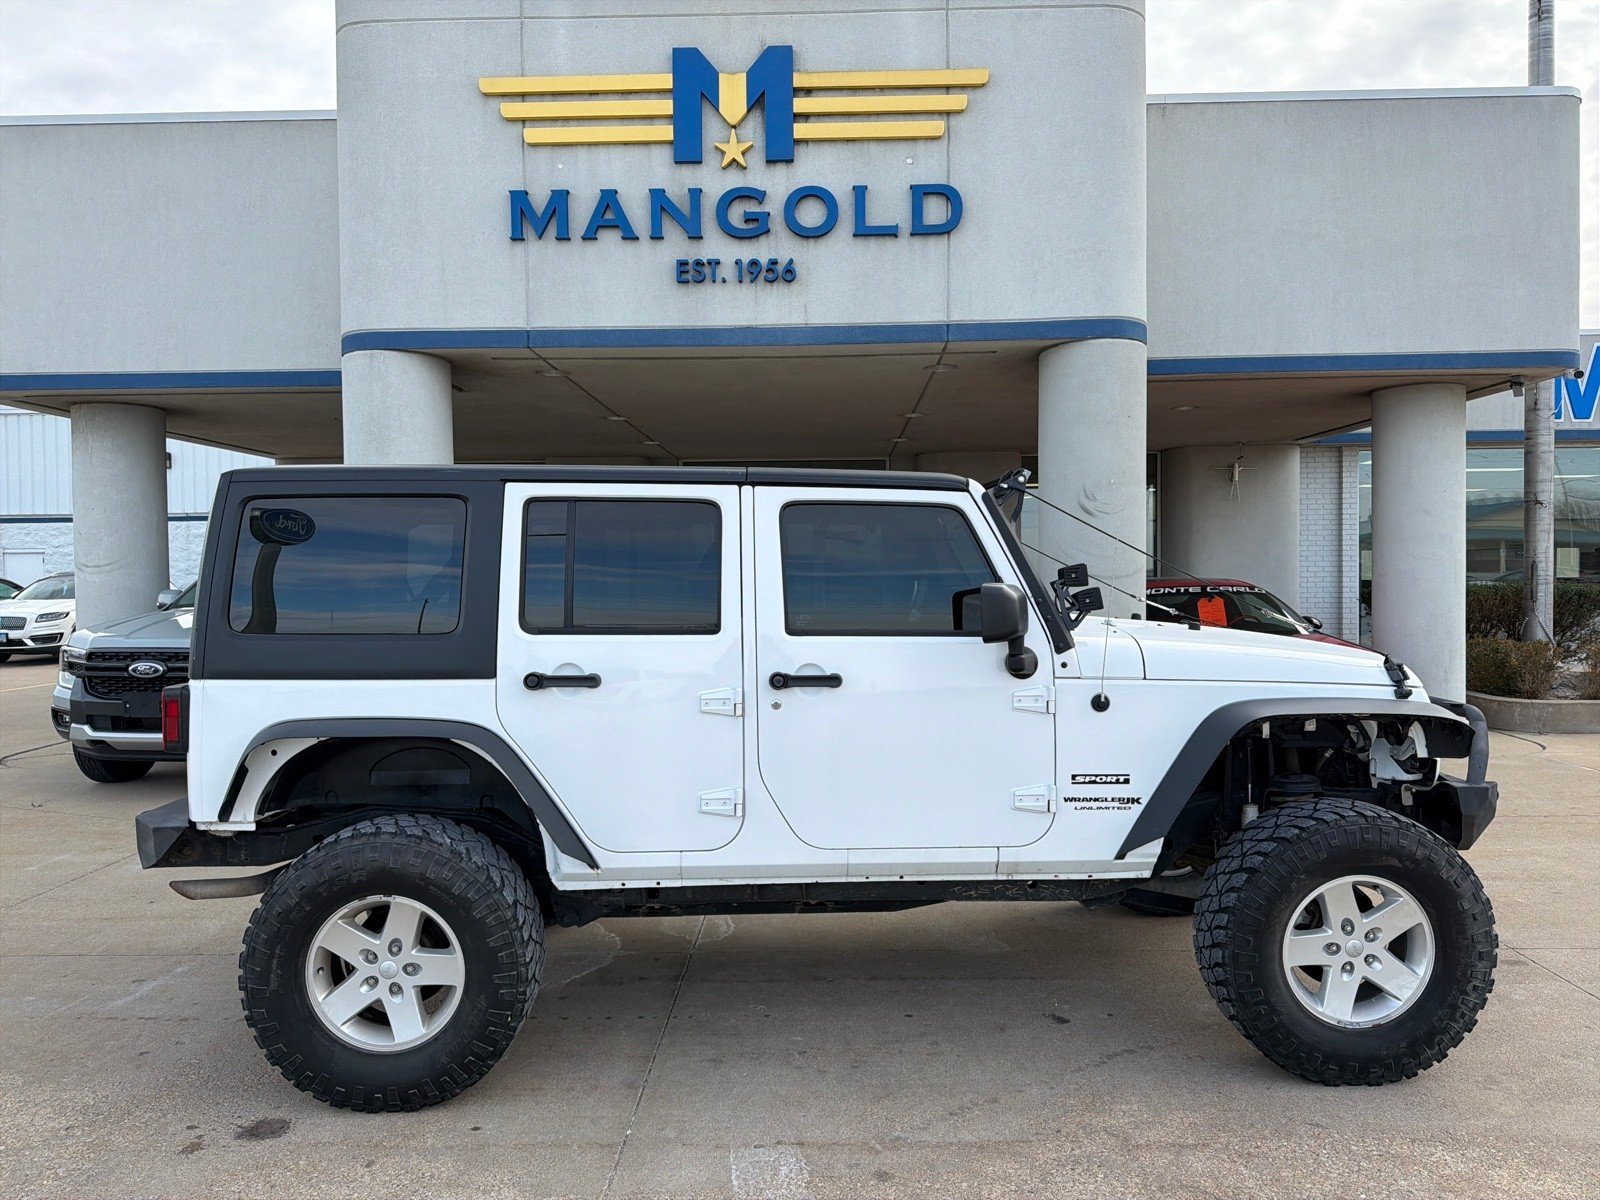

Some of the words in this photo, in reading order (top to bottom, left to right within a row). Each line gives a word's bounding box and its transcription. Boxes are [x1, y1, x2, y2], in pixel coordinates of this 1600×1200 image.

[508, 184, 963, 241] MANGOLD
[676, 258, 726, 284] EST.
[734, 257, 797, 283] 1956
[1206, 586, 1266, 594] CARLO
